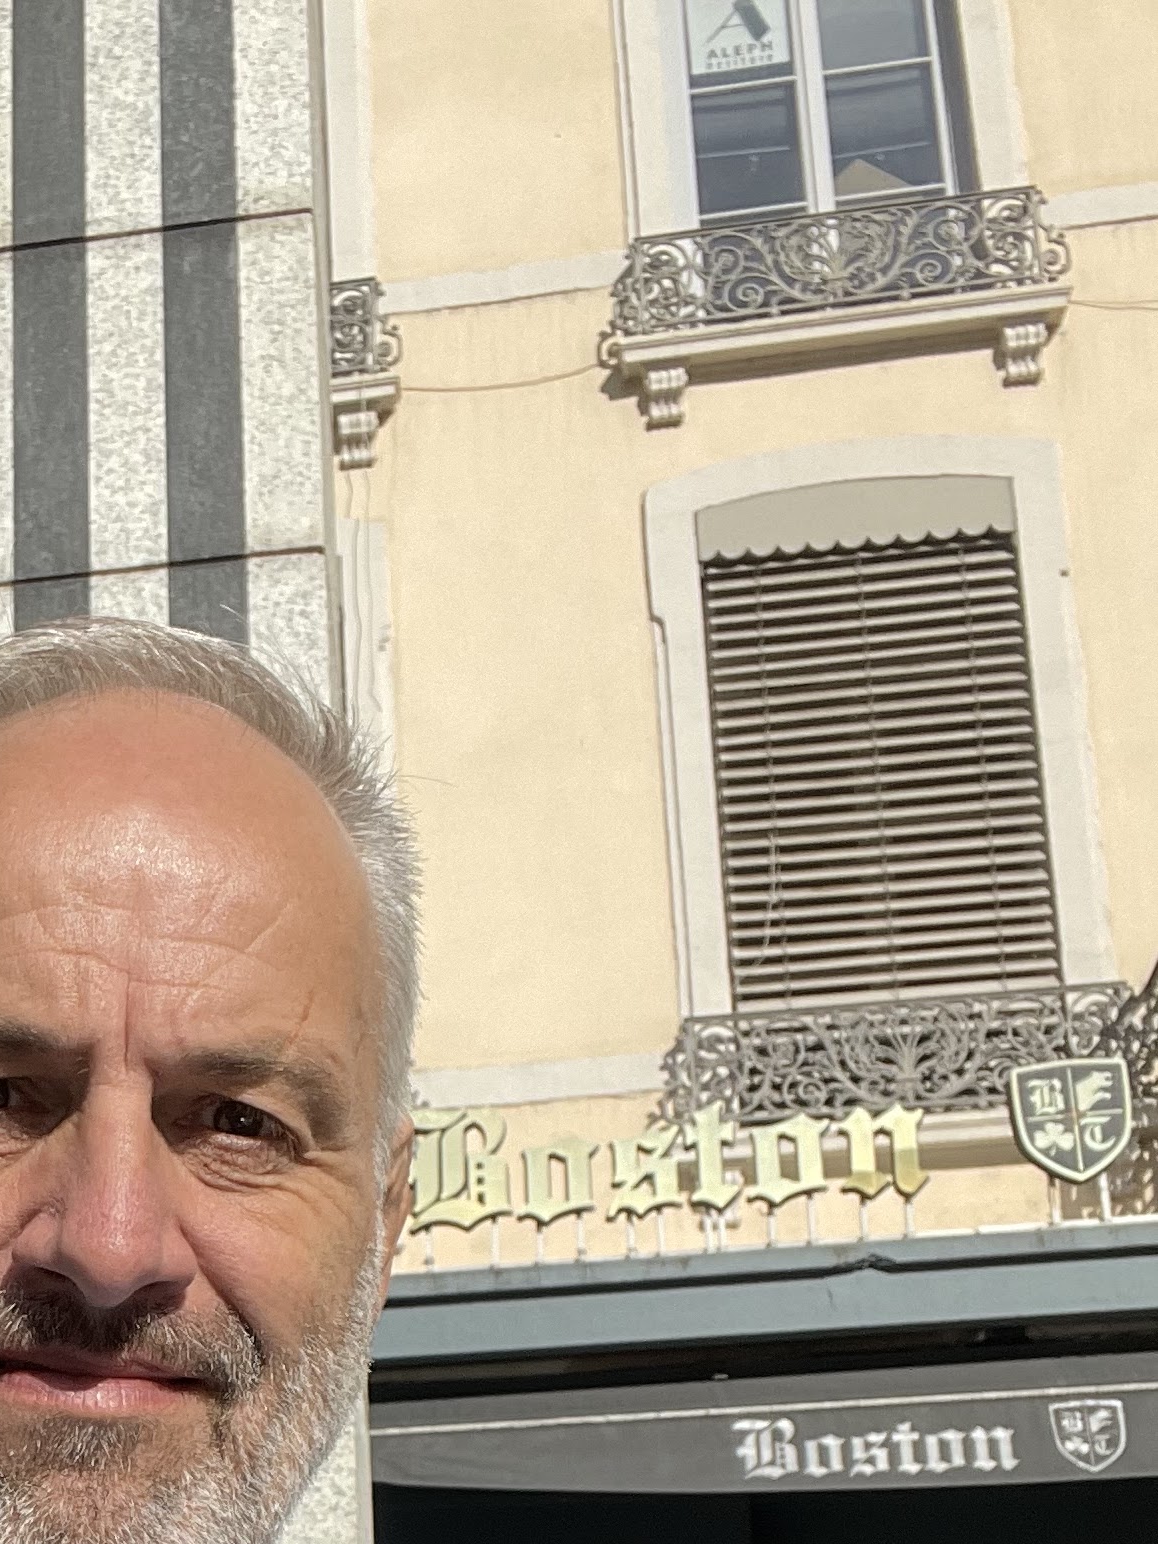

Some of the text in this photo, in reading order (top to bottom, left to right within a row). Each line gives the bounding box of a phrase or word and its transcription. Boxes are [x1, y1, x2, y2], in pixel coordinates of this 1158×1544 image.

[706, 40, 773, 60] ALEPH
[409, 1101, 930, 1234] Boston
[731, 1417, 1021, 1481] Boston
